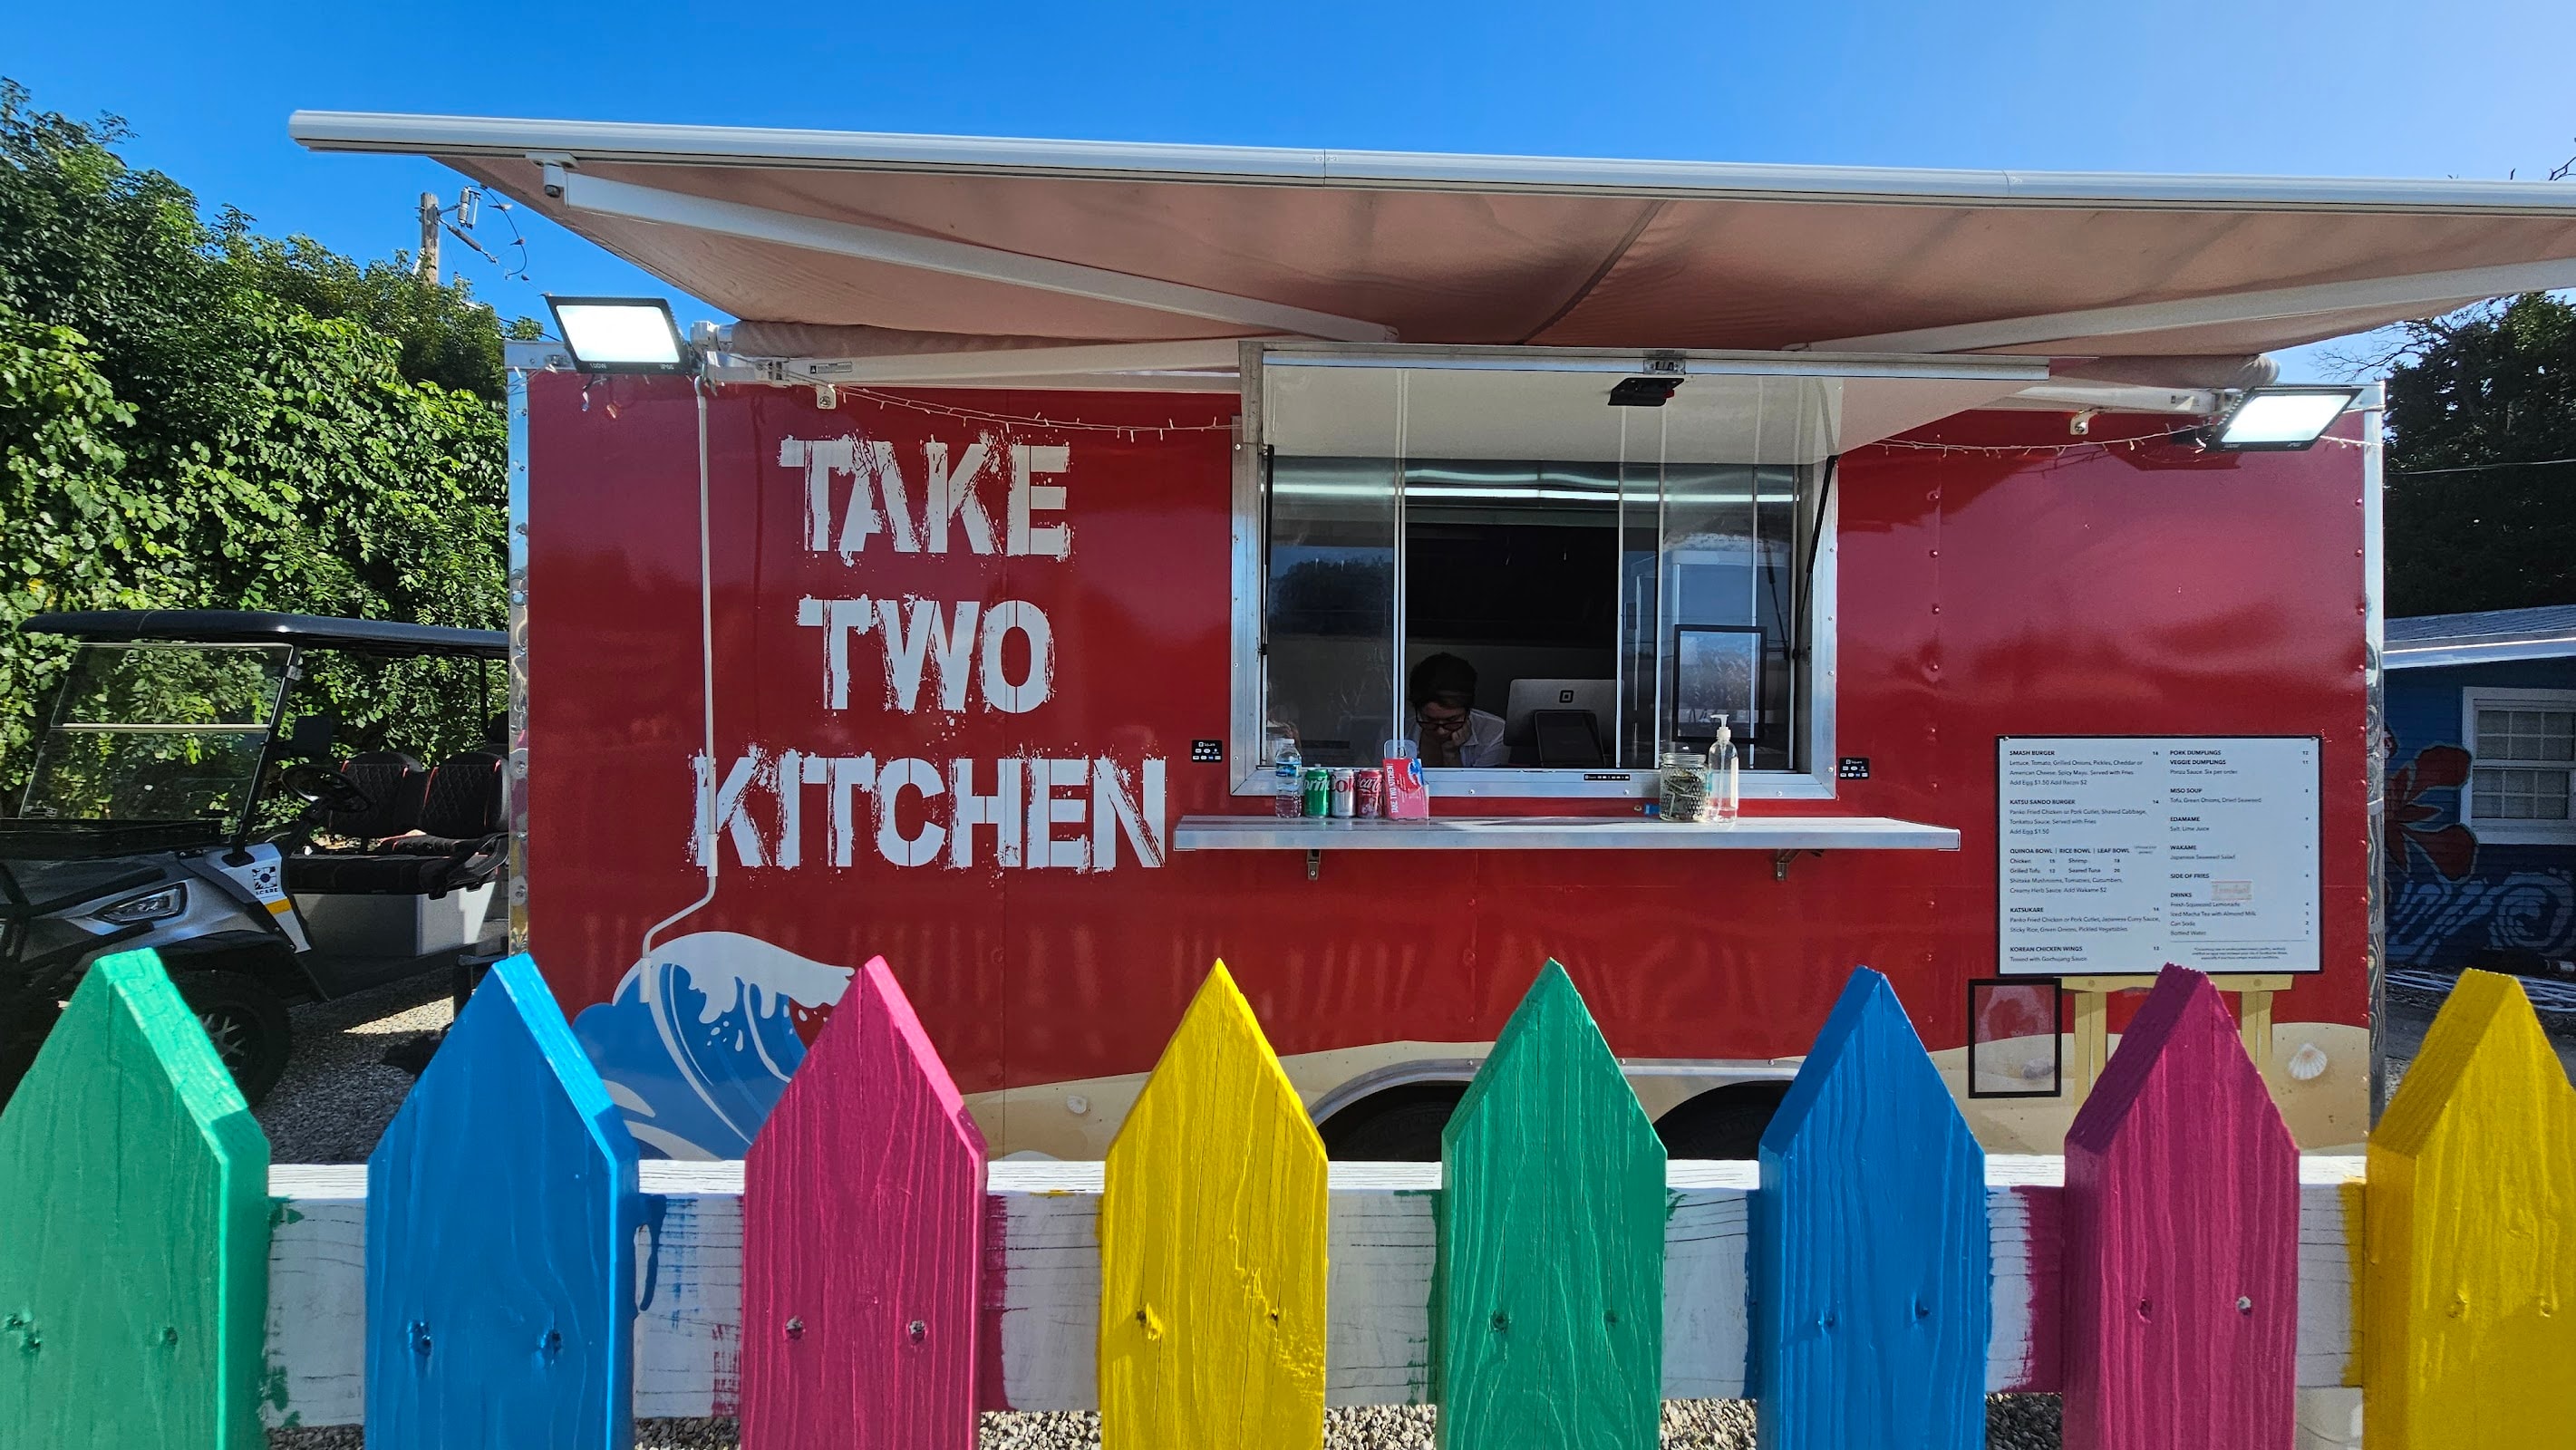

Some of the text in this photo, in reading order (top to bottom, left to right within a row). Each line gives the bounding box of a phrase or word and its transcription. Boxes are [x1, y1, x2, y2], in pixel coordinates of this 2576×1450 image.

[778, 435, 1071, 559] TAKE
[796, 594, 1056, 714] TWO
[691, 747, 1167, 872] KITCHEN
